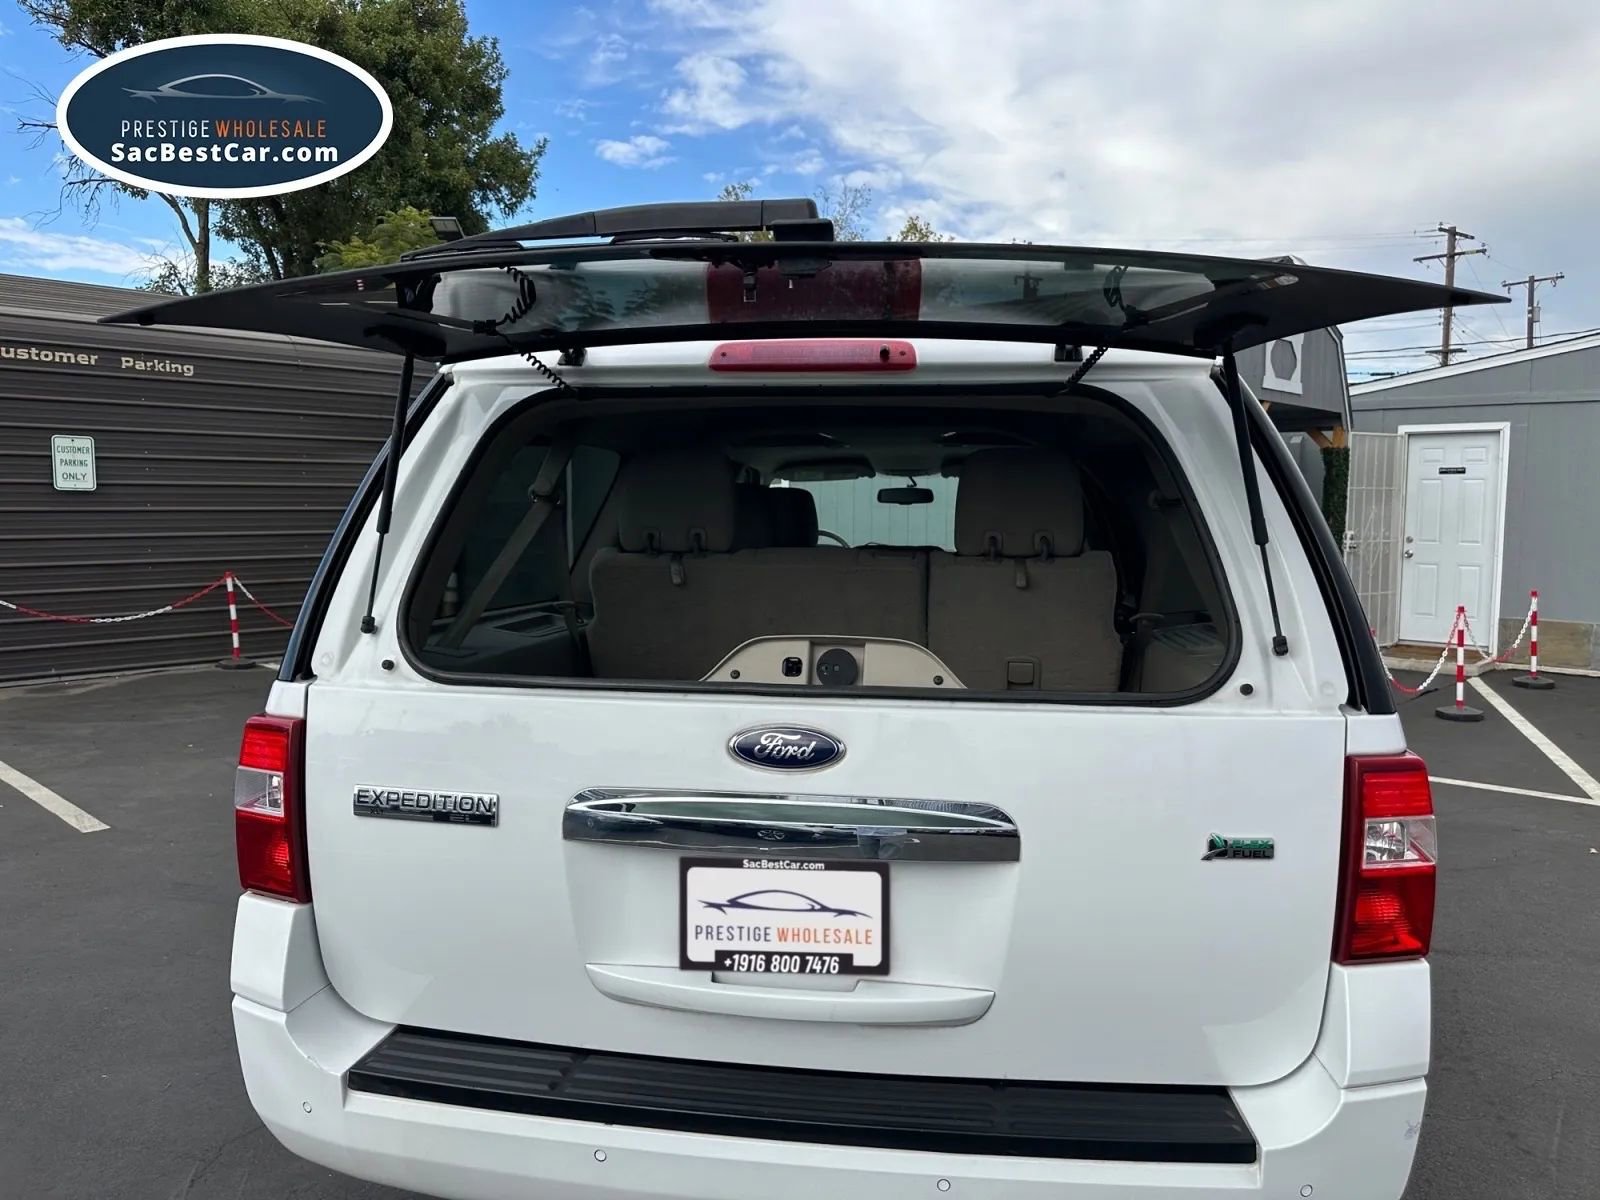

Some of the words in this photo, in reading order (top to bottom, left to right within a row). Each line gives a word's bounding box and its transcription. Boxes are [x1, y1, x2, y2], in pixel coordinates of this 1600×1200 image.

[0, 346, 98, 365] ustomer
[121, 357, 194, 376] Parking
[56, 445, 90, 454] CUSTOMER
[60, 458, 88, 467] PARKING
[61, 472, 87, 481] ONLY
[754, 732, 817, 760] Ford
[357, 789, 493, 813] EXPEDITION
[1232, 839, 1271, 849] FLEX
[1232, 849, 1272, 859] FUEL
[742, 858, 826, 871] SacBestCar.com
[694, 924, 772, 943] PRESTIGE
[776, 926, 873, 945] WHOLESALE
[723, 953, 766, 973] +1916
[770, 955, 800, 973] 800
[805, 956, 840, 974] 7476
